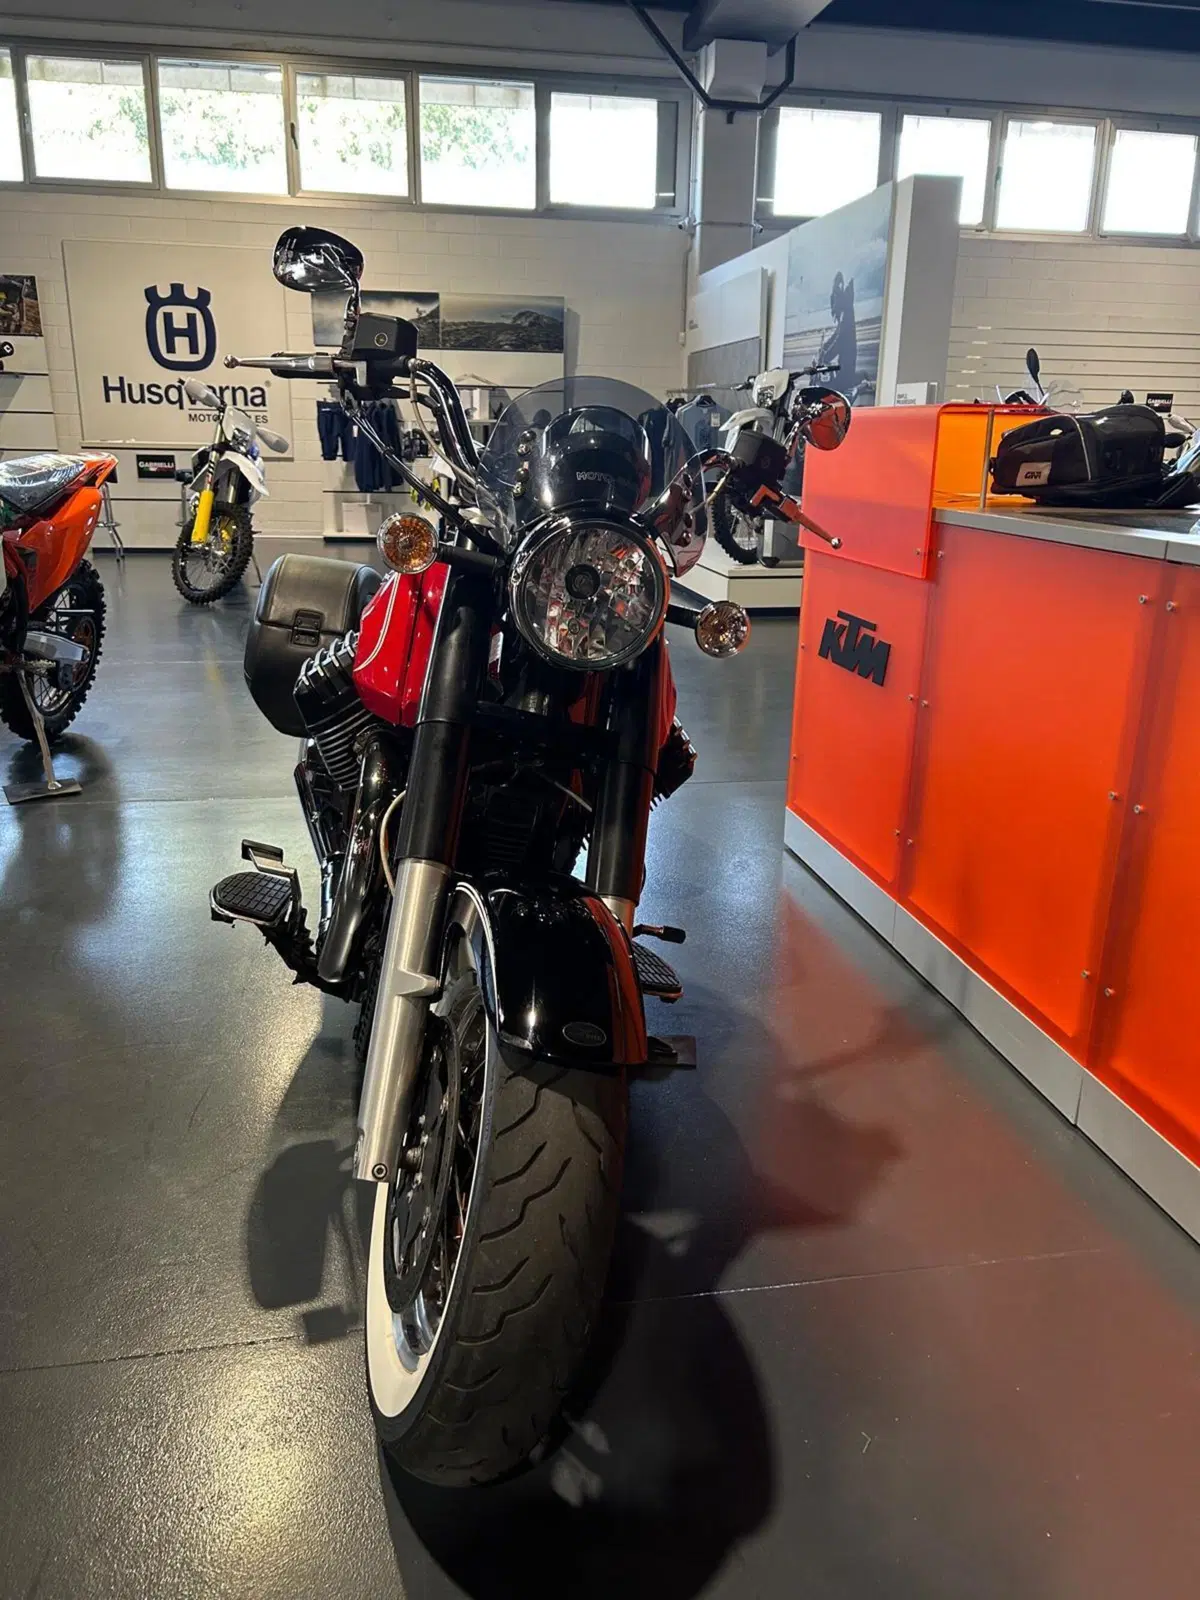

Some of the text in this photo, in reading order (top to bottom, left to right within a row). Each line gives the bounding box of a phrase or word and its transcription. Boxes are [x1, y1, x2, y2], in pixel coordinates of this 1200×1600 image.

[163, 311, 200, 355] H
[1024, 471, 1042, 480] GIVI
[818, 610, 892, 687] KTM
